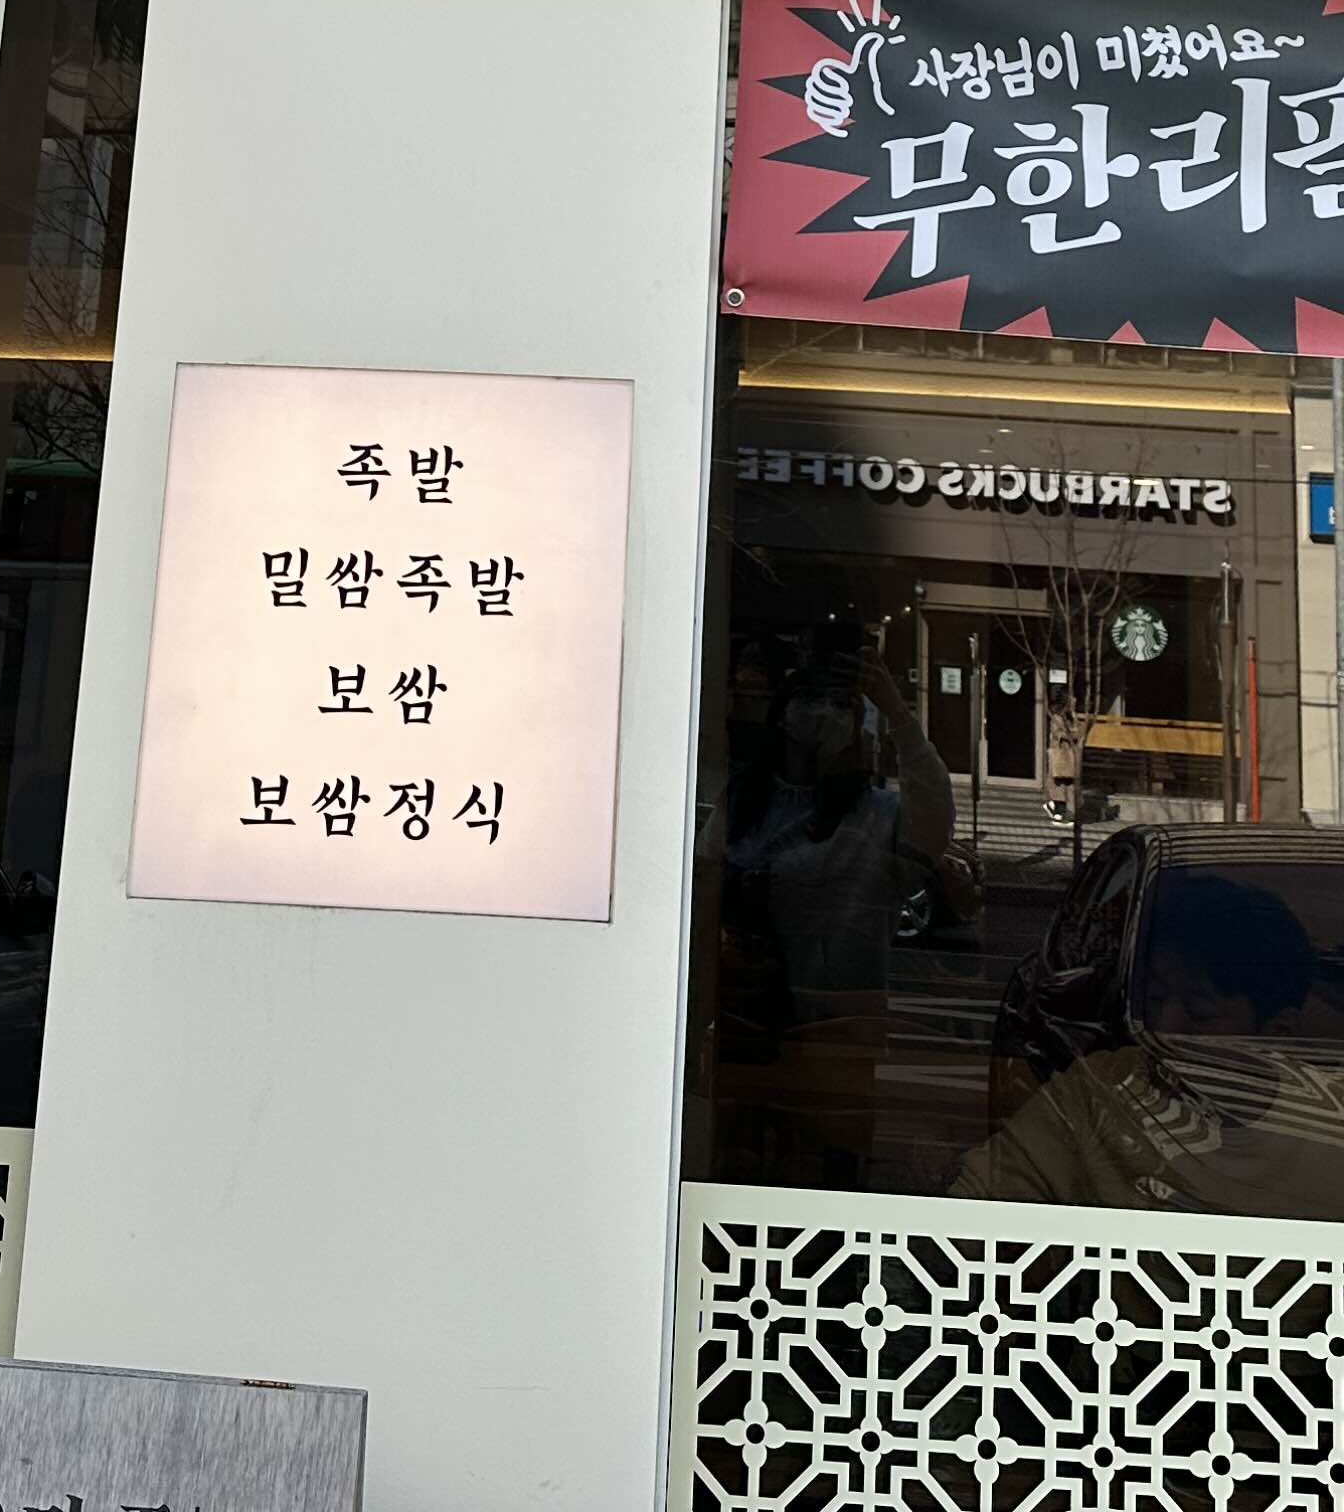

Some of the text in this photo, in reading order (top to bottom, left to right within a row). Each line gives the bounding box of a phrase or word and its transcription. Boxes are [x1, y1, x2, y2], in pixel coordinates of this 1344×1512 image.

[908, 23, 1305, 100] 사장님이 미쳤어요~
[336, 443, 464, 504] 족발
[262, 547, 525, 617] 밀쌈족발
[317, 663, 448, 725] 보쌈
[239, 774, 504, 845] 보쌈정식
